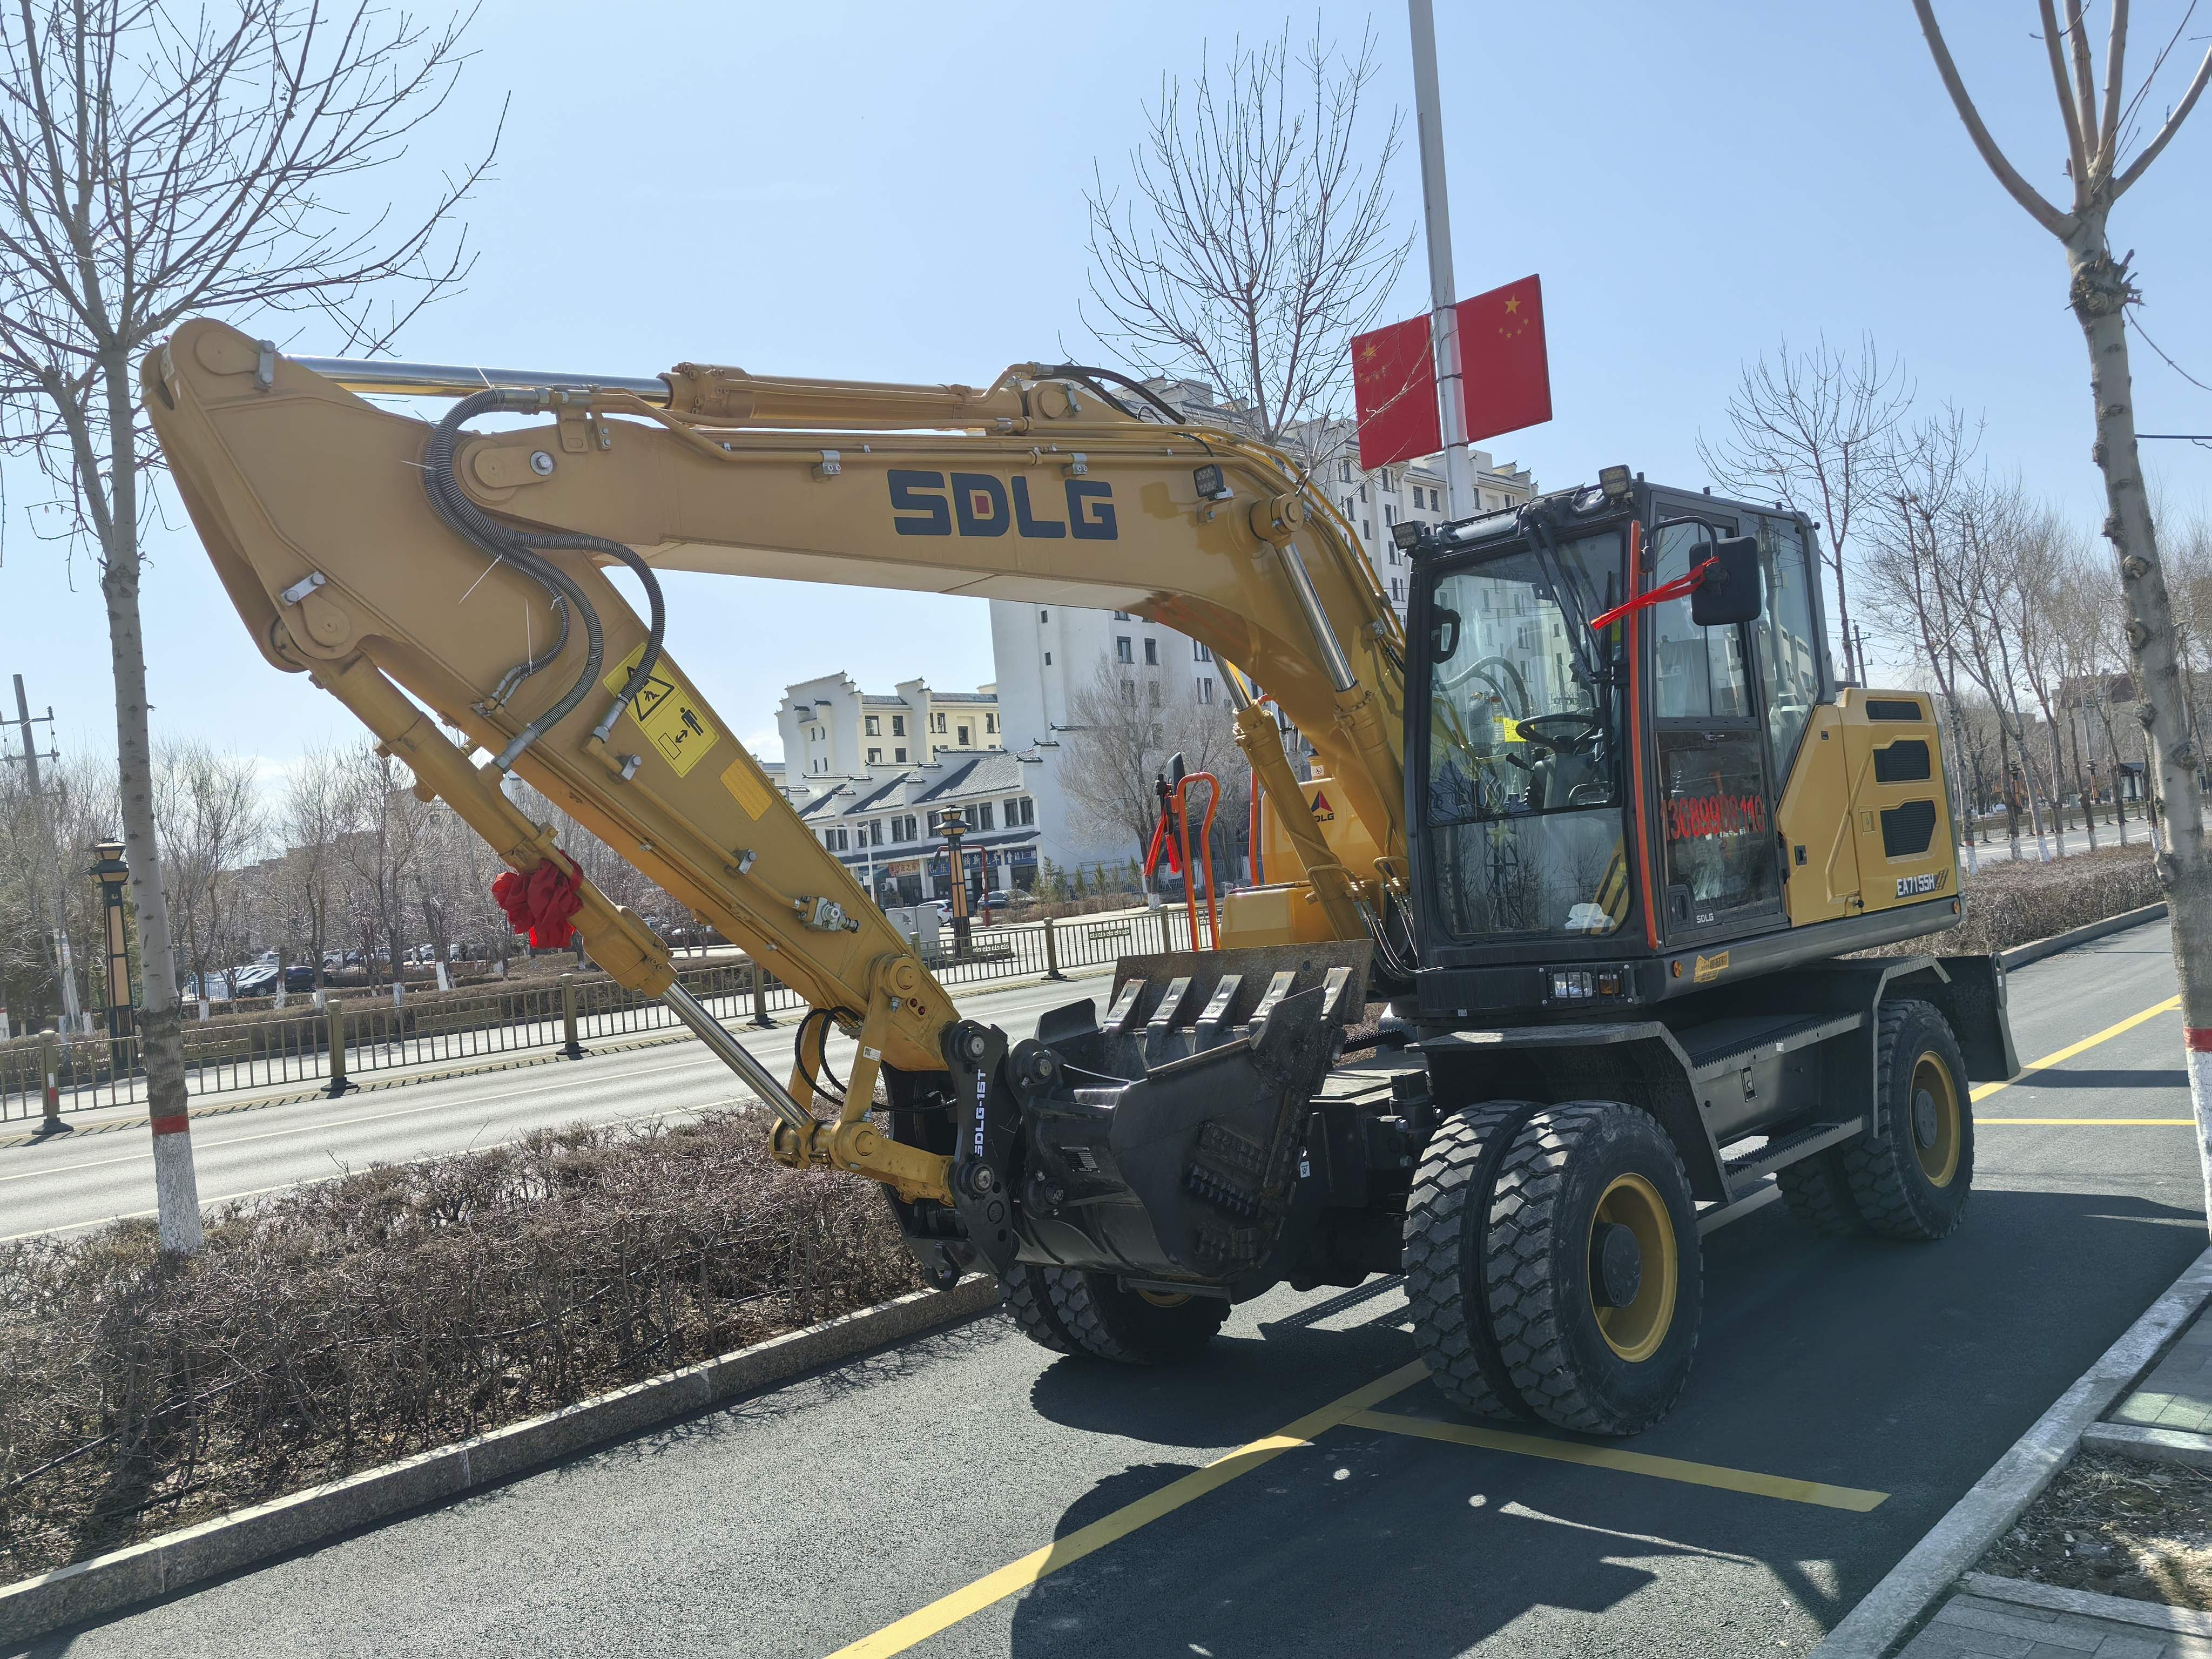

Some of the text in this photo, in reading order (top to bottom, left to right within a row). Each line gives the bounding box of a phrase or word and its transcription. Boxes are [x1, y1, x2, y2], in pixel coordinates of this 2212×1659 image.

[887, 469, 1118, 540] SDLG
[1314, 813, 1334, 822] DLG
[1897, 873, 1934, 896] EA7155H
[1696, 913, 1714, 923] SDLG
